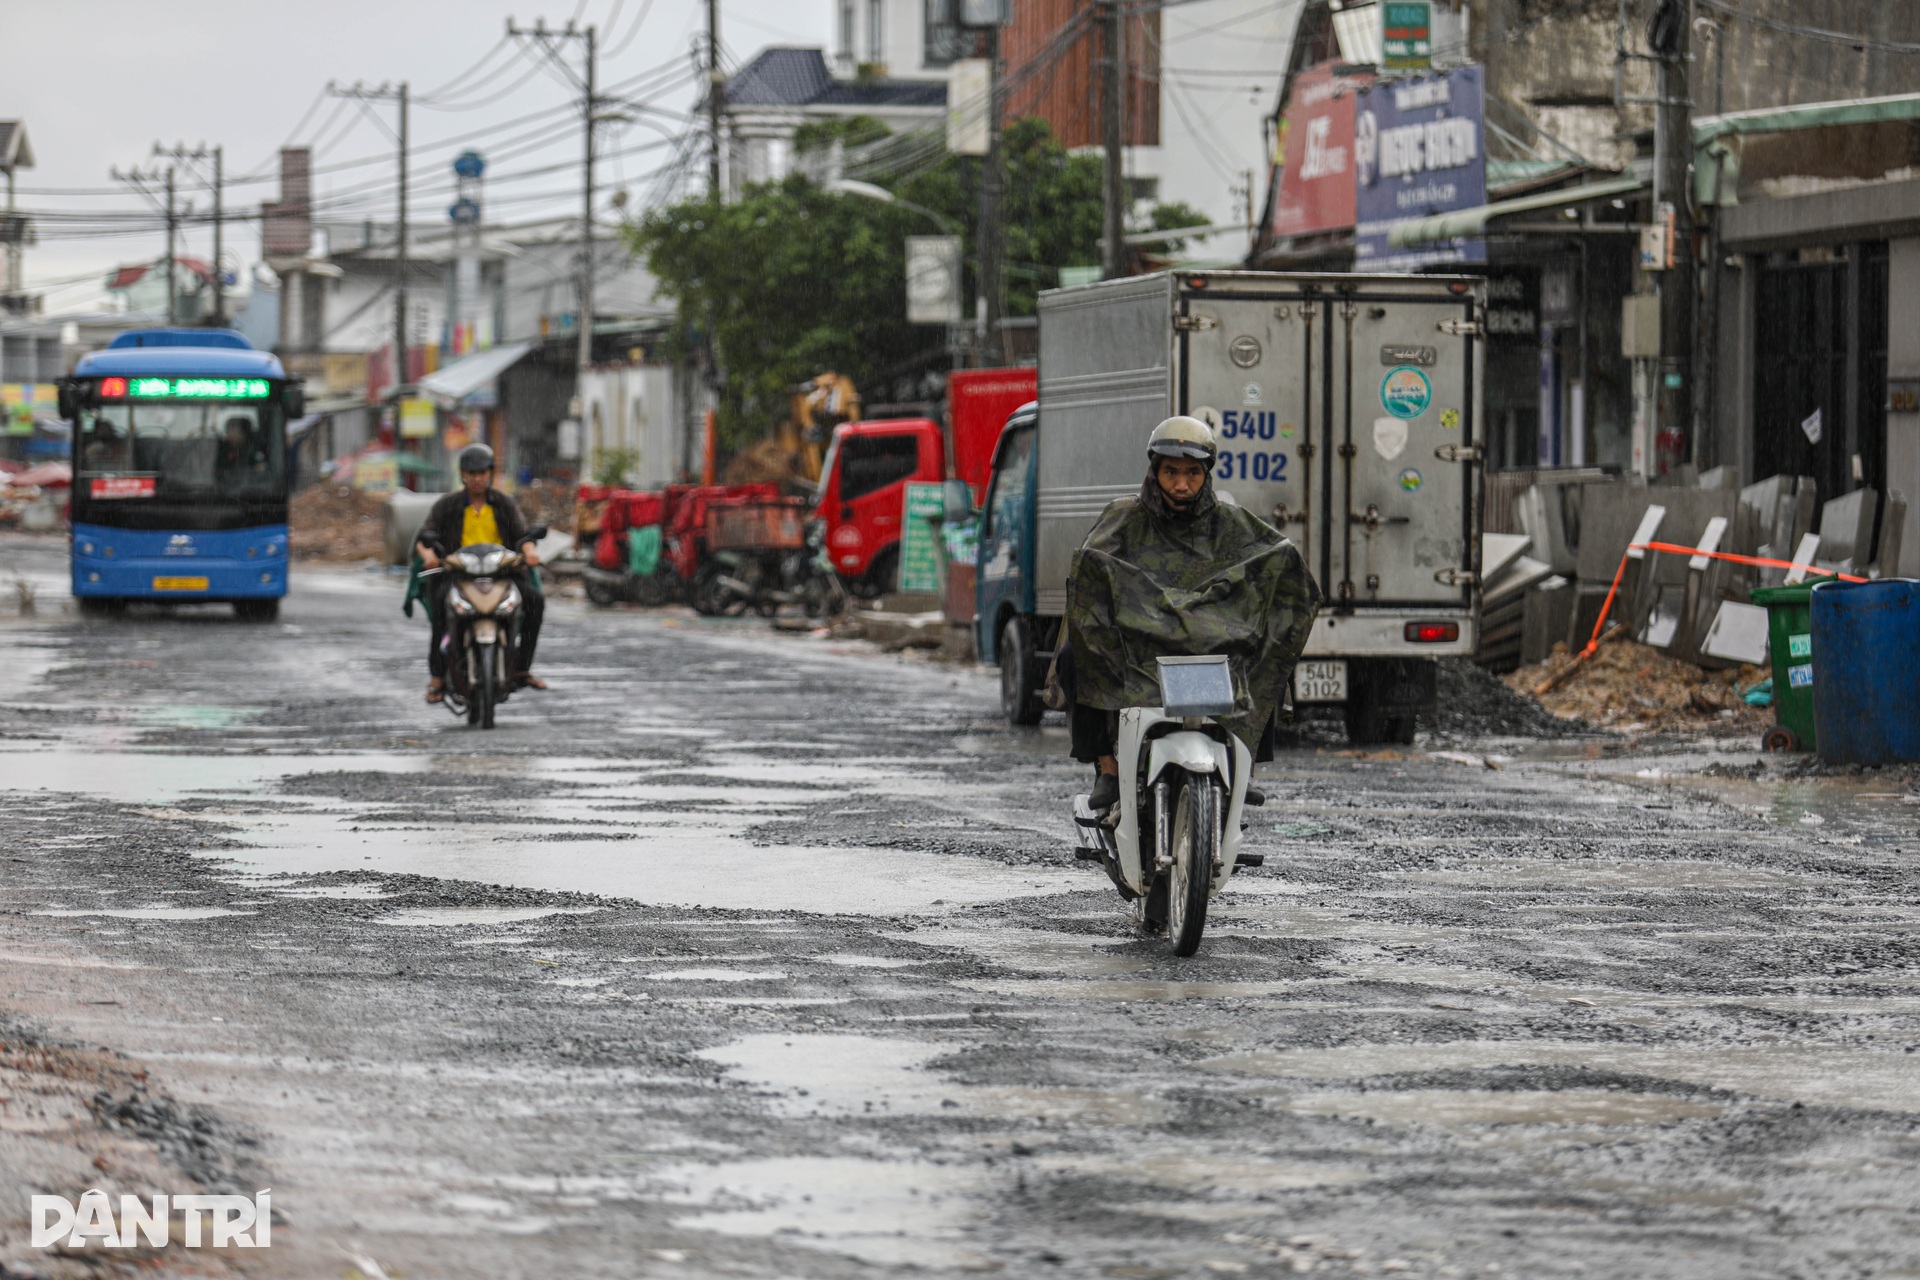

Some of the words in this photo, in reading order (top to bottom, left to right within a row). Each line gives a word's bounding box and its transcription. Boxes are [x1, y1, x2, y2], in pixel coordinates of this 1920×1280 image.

[1222, 410, 1275, 440] 54U
[1217, 451, 1287, 482] 3102
[1306, 663, 1336, 680] 54U
[1302, 681, 1341, 697] 3102
